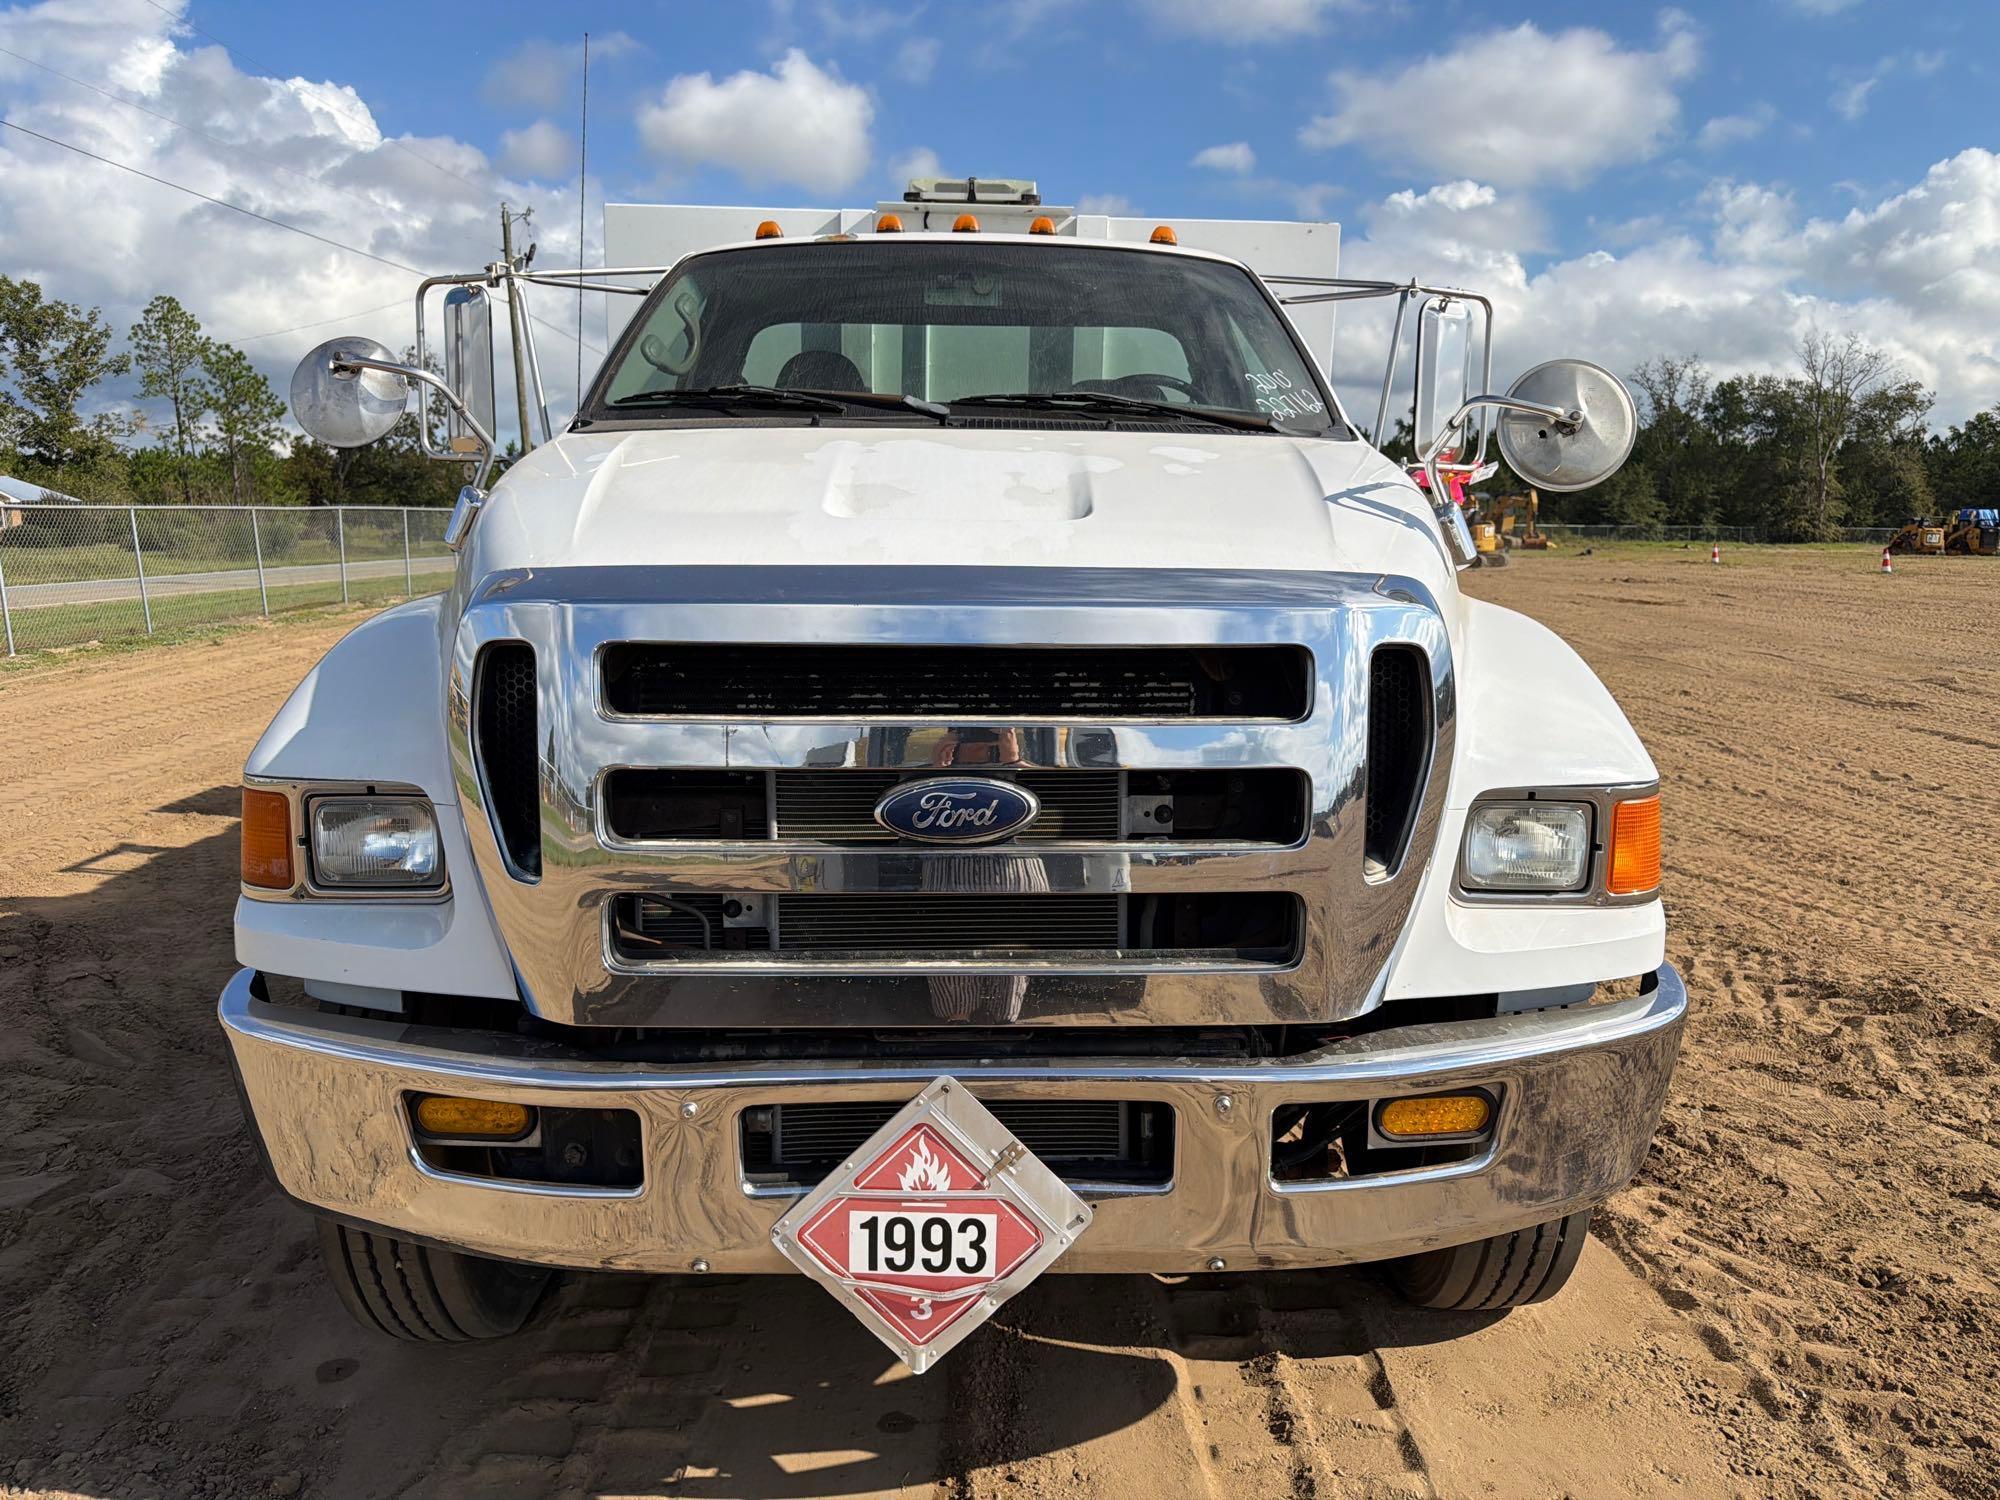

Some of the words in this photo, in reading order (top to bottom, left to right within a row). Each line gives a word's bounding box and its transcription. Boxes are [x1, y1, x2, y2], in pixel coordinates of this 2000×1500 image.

[1926, 533, 1940, 543] CAT
[912, 792, 999, 829] Ford
[859, 1215, 988, 1275] 1993
[910, 1295, 933, 1321] 3
